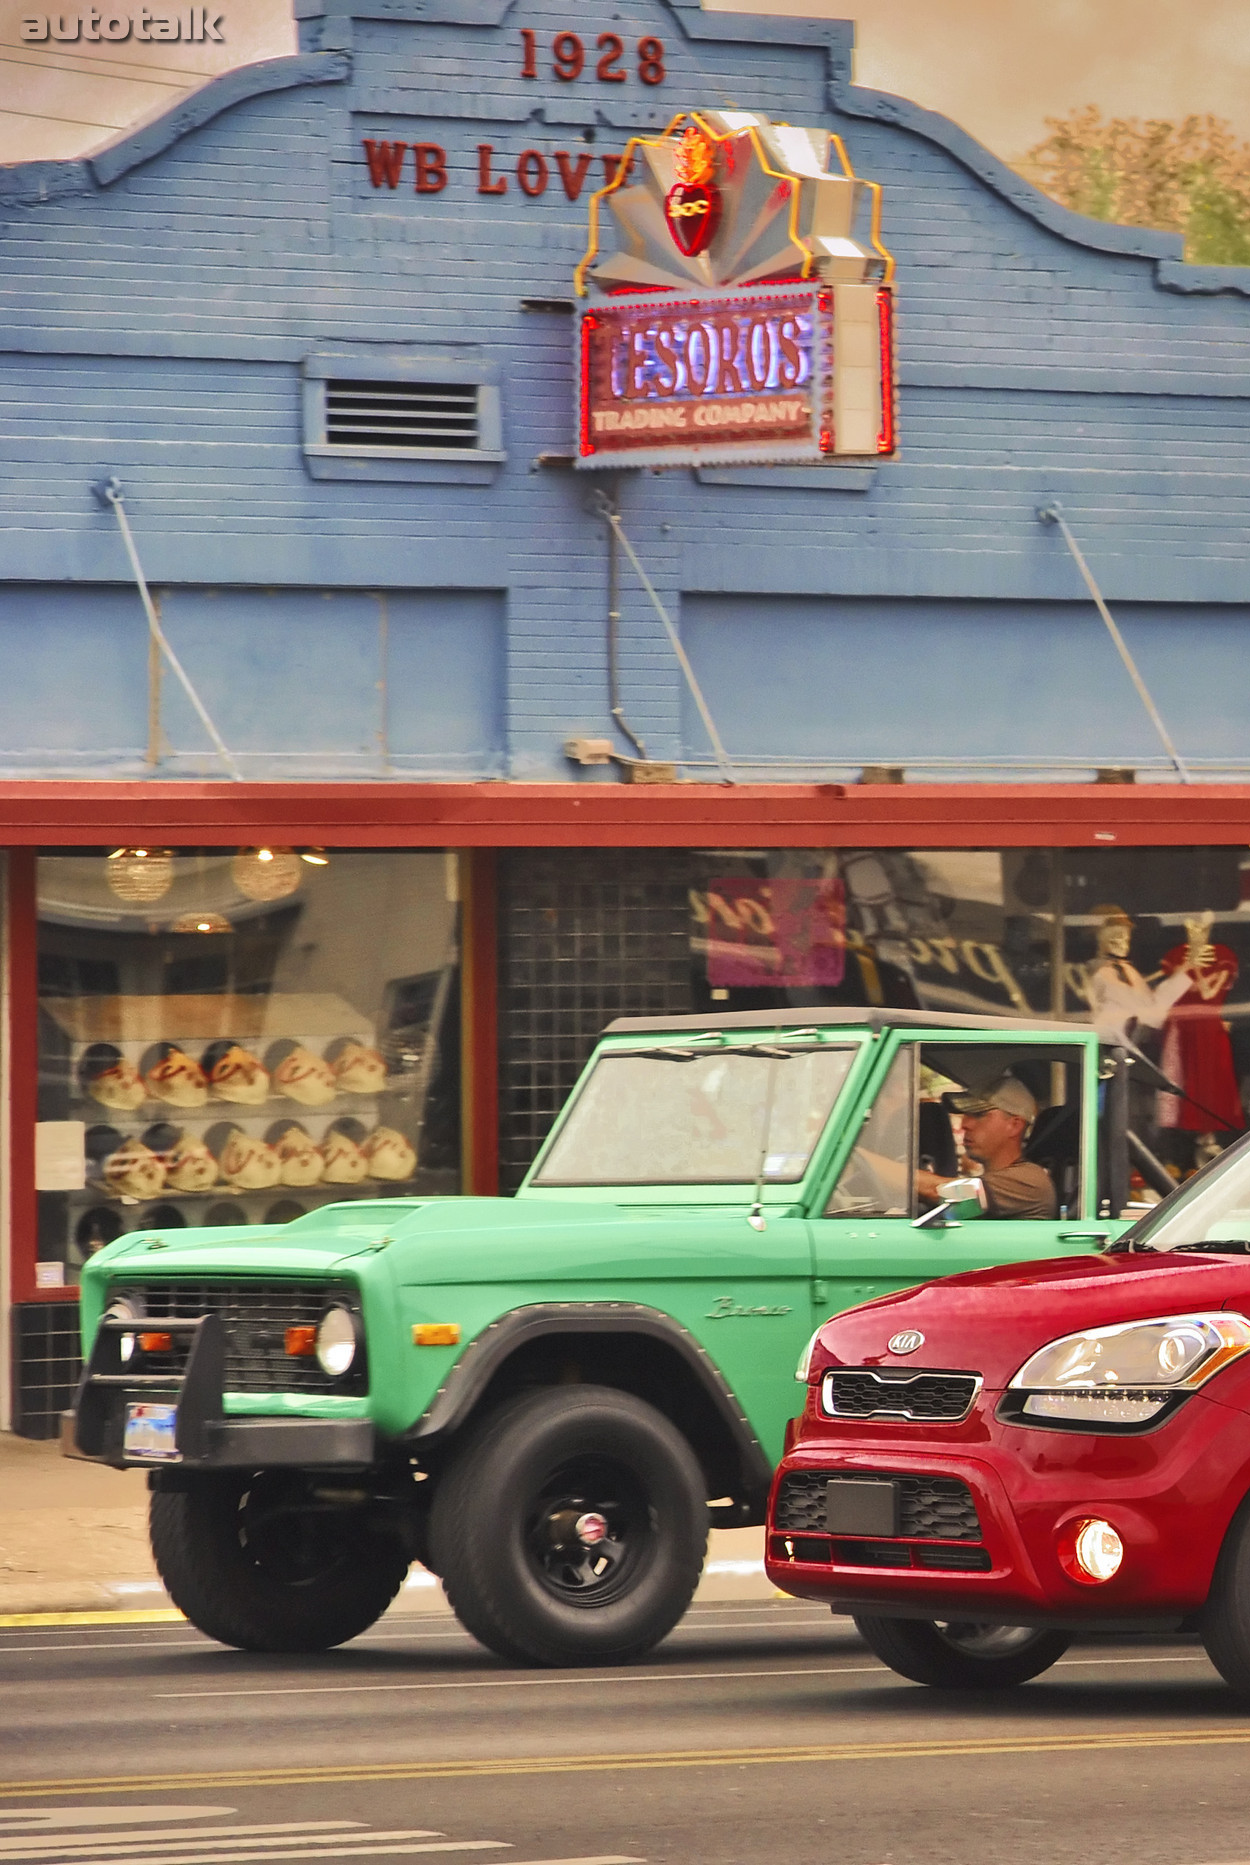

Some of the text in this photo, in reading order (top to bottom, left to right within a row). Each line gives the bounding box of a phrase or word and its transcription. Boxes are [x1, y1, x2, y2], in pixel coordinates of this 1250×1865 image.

[520, 28, 666, 85] 1928
[362, 138, 449, 193] WB
[592, 401, 801, 431] TRADING COMPANY
